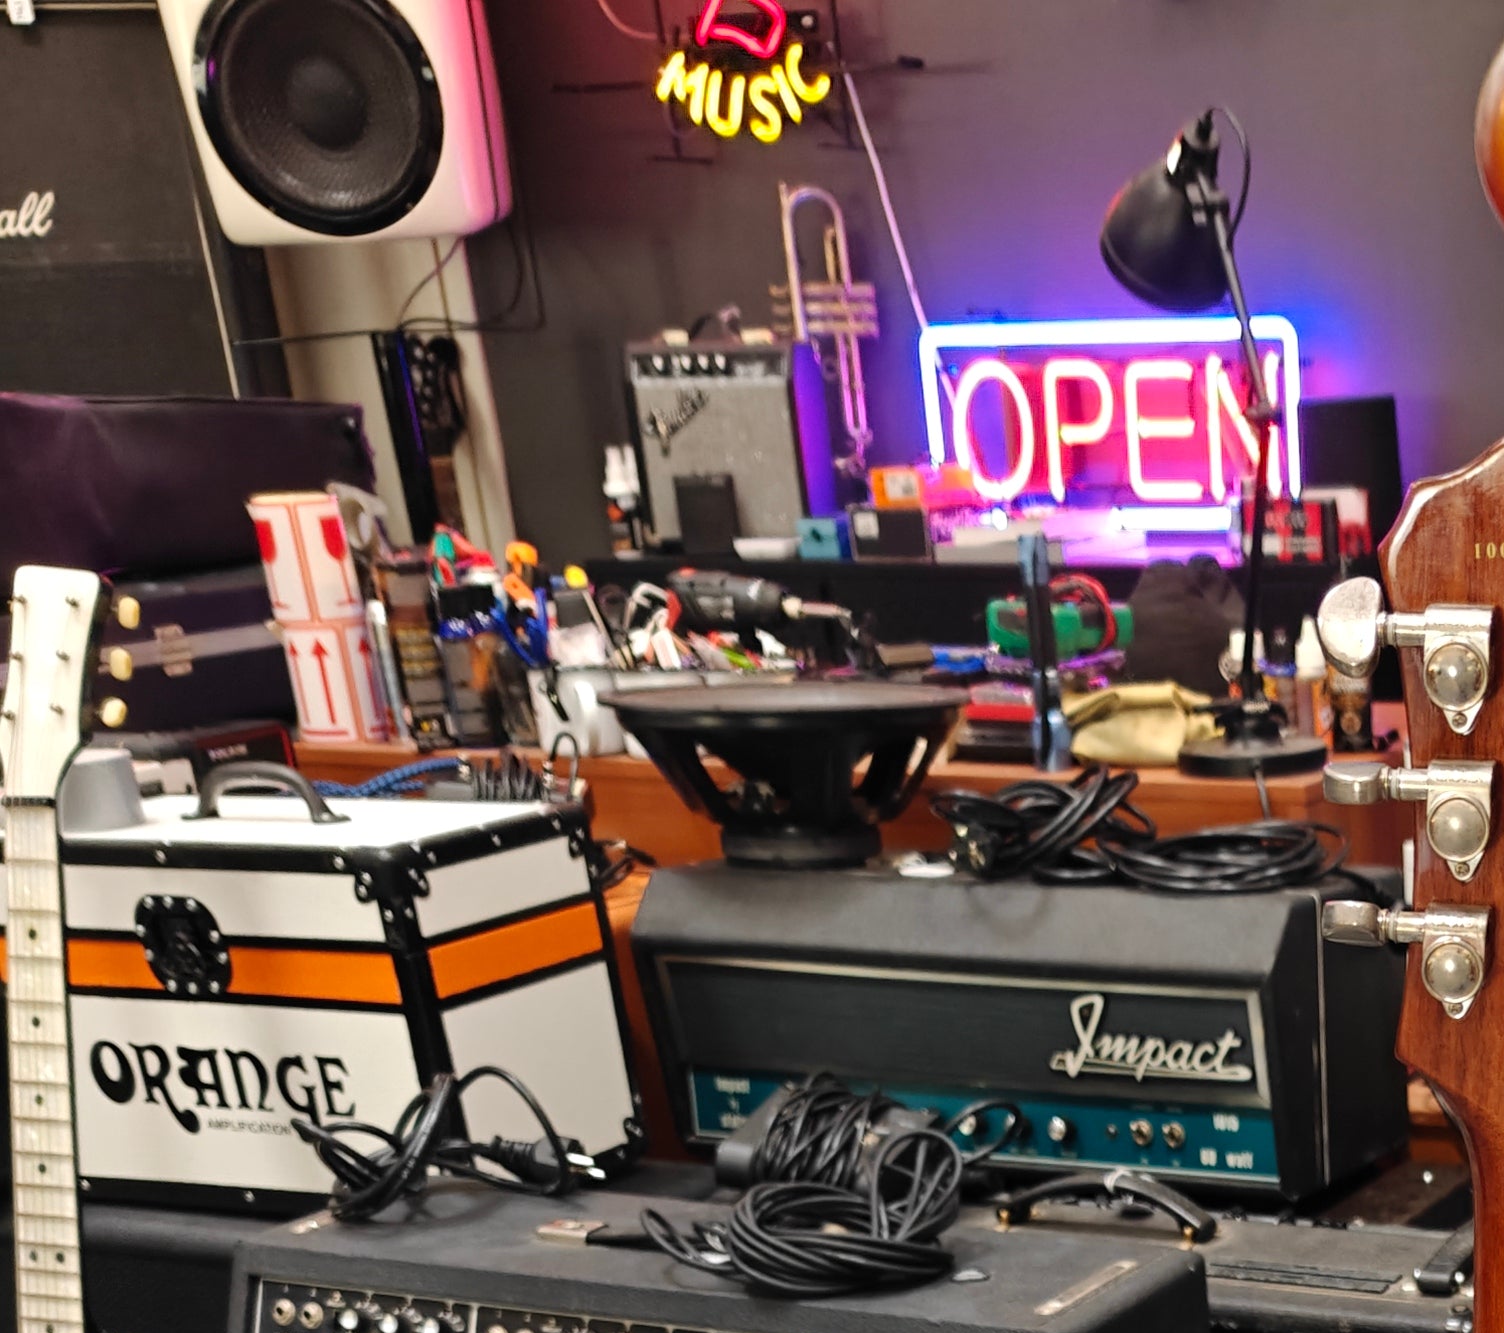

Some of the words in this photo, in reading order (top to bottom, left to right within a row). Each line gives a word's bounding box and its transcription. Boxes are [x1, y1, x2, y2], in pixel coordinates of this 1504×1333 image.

[656, 42, 831, 143] MUSIC
[0, 190, 55, 237] all
[953, 350, 1283, 503] OPEN
[1050, 993, 1252, 1082] Impact
[90, 1040, 356, 1135] ORANGE
